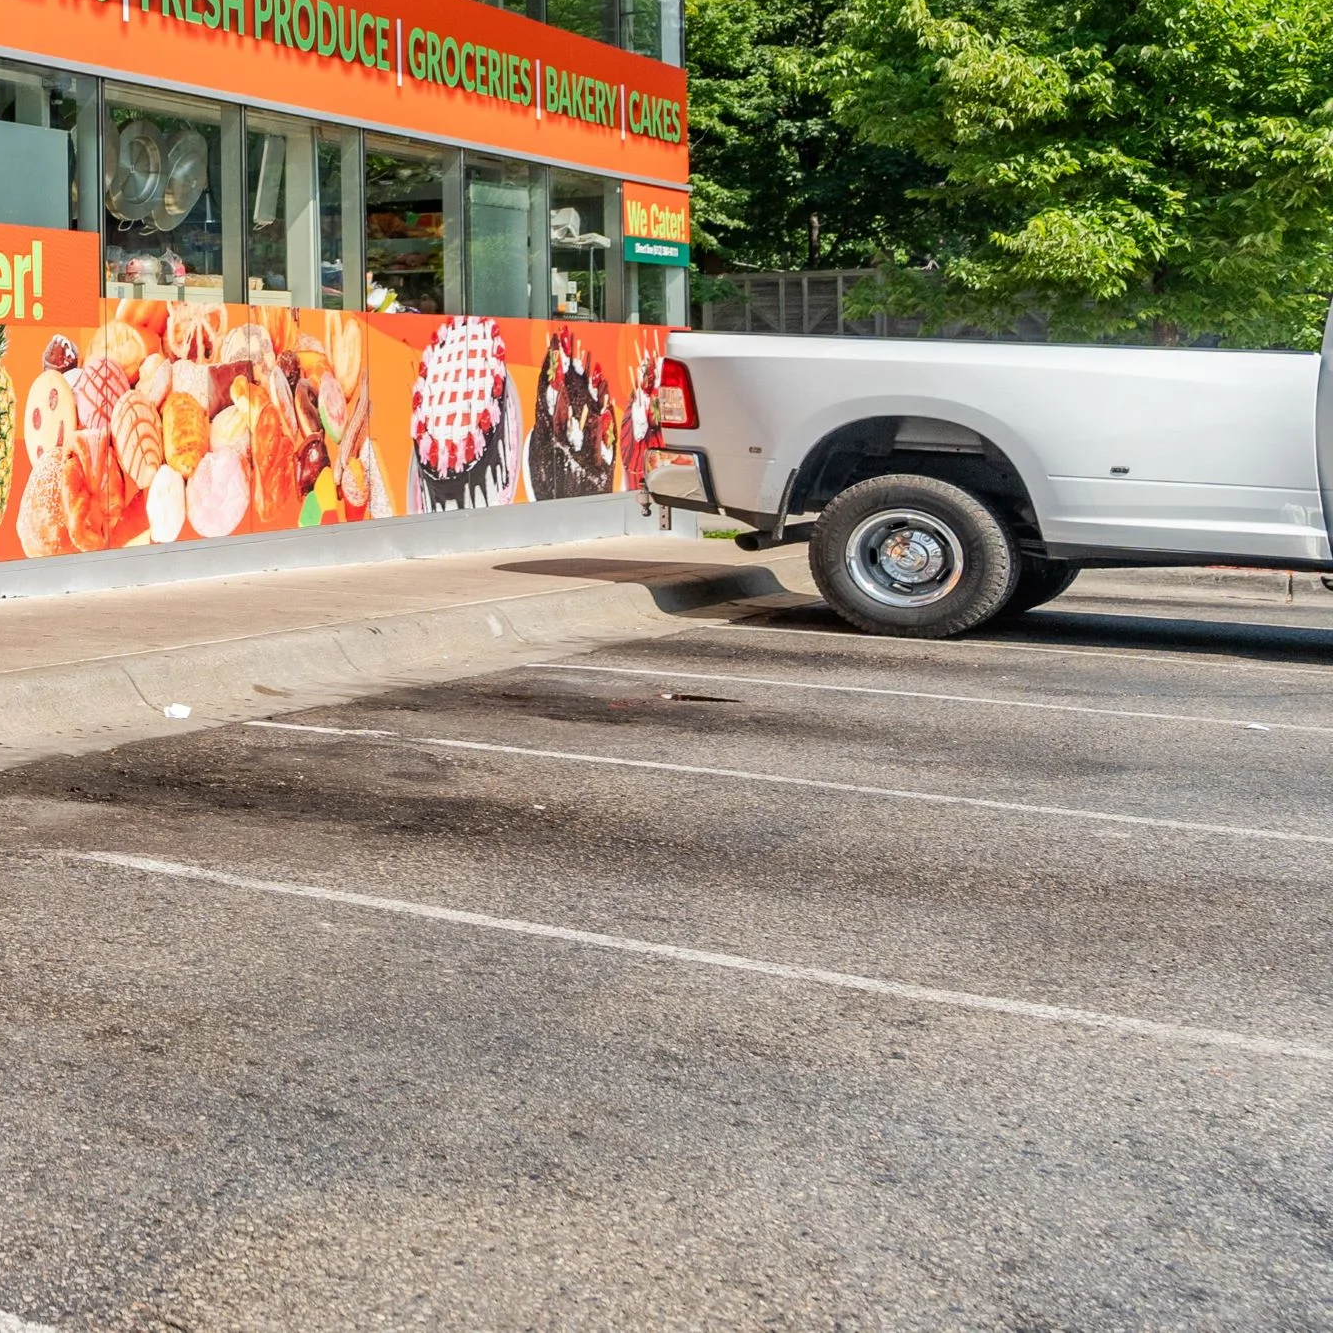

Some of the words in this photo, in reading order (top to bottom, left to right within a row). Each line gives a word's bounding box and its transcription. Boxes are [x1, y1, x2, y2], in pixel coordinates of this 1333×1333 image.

[408, 27, 532, 106] GROCERIES
[545, 65, 618, 127] BAKERY
[629, 90, 681, 144] CAKES
[627, 200, 648, 236] We
[650, 203, 685, 240] Cater!
